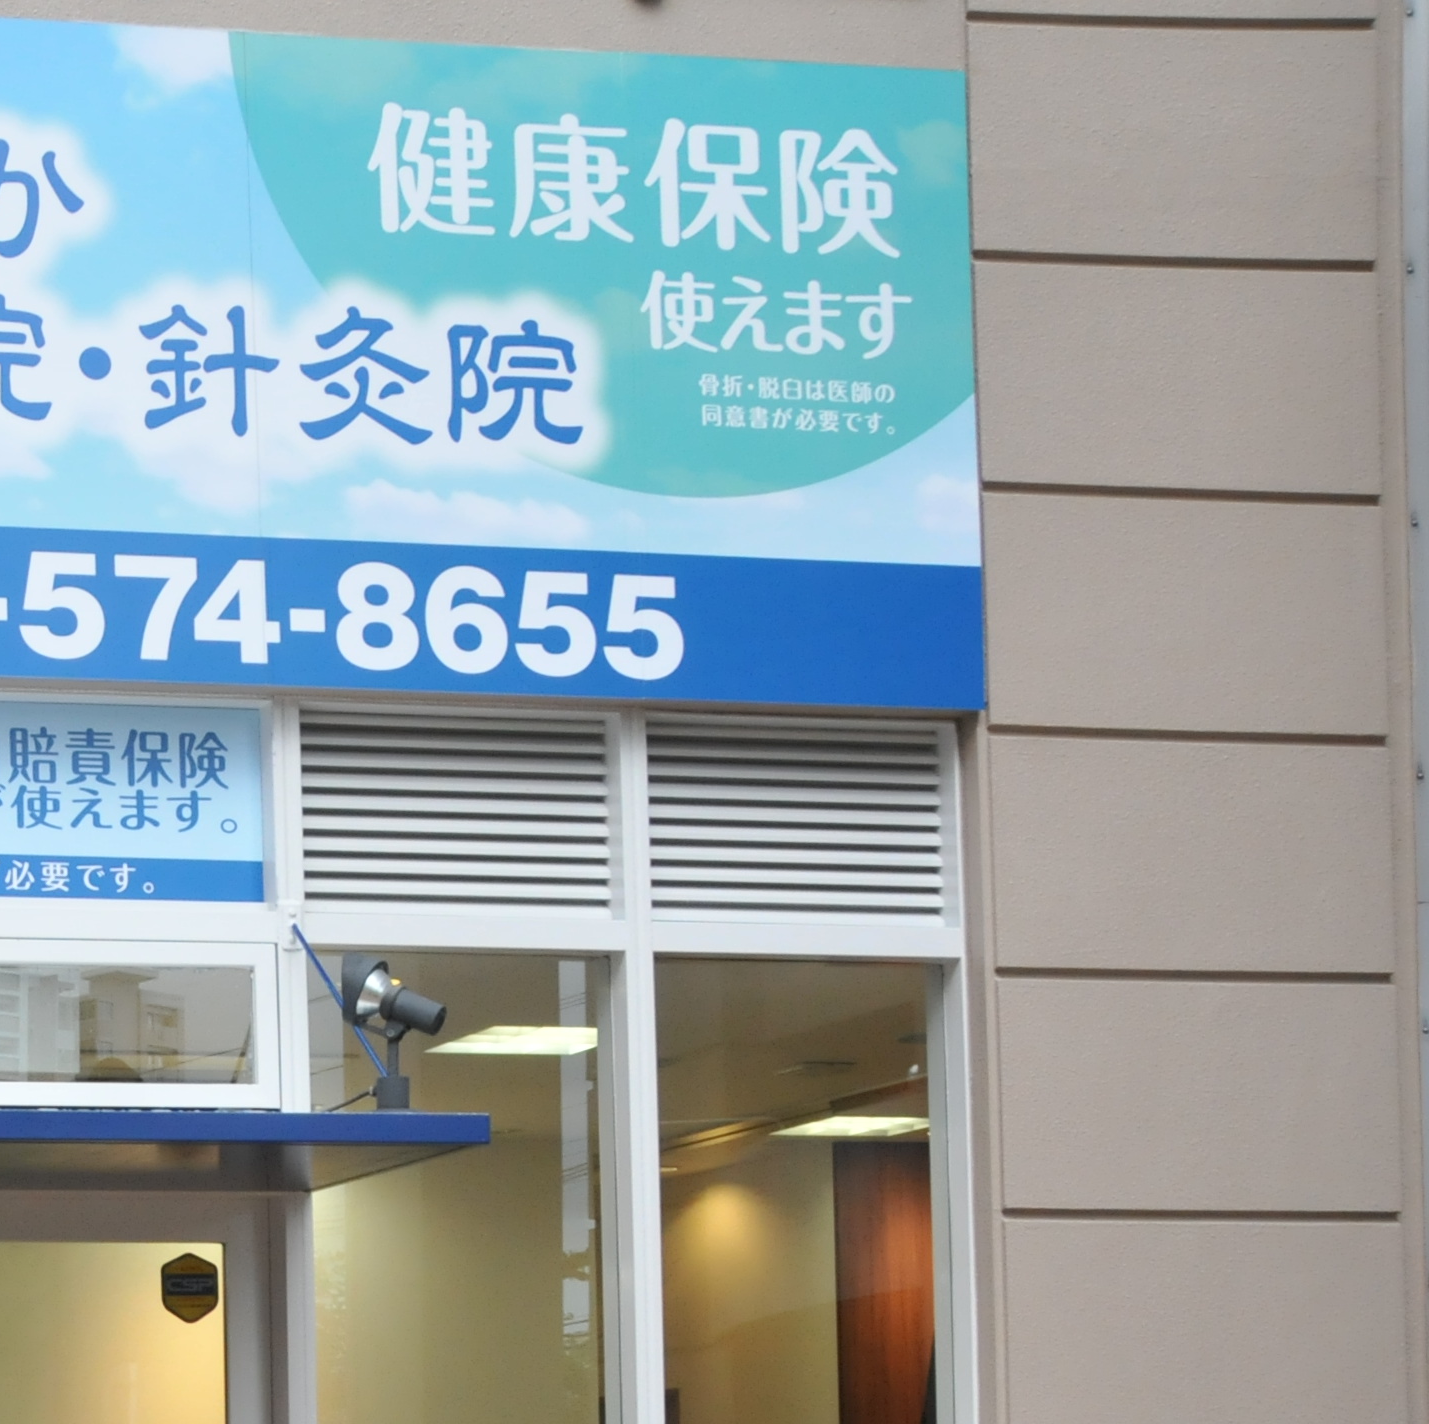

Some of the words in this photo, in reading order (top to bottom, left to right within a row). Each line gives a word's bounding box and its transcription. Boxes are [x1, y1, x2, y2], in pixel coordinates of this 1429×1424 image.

[367, 101, 902, 259] 健康保険
[640, 269, 913, 360] 使えます
[701, 404, 896, 435] 同意書が必要です。
